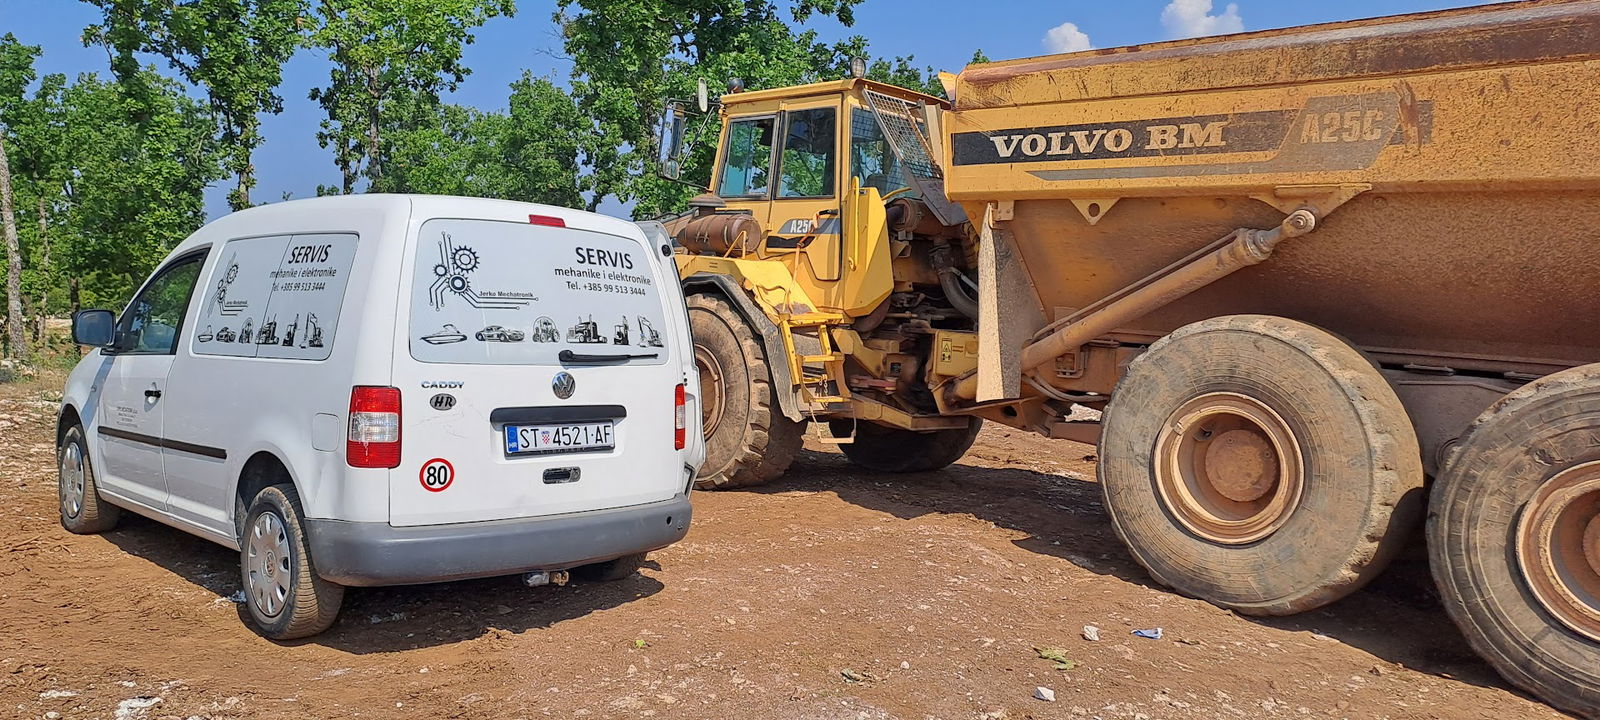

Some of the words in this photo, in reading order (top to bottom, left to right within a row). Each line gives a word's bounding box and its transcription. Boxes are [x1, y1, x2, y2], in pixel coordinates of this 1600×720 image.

[1300, 109, 1384, 144] A25C
[990, 128, 1133, 158] VOLVO
[1145, 121, 1228, 150] BM
[288, 244, 332, 264] SERVIS
[575, 247, 633, 270] SERVIS
[302, 267, 337, 277] elektronike
[555, 267, 601, 279] mehanike
[602, 270, 606, 279] i
[608, 271, 651, 285] elektronike
[566, 281, 581, 290] Tel.
[583, 282, 602, 292] +385
[604, 284, 613, 292] 99
[615, 285, 628, 294] 513
[630, 286, 646, 296] 3444
[421, 381, 464, 389] CADDY
[434, 395, 453, 408] HR
[520, 428, 539, 449] ST
[426, 465, 448, 486] 80
